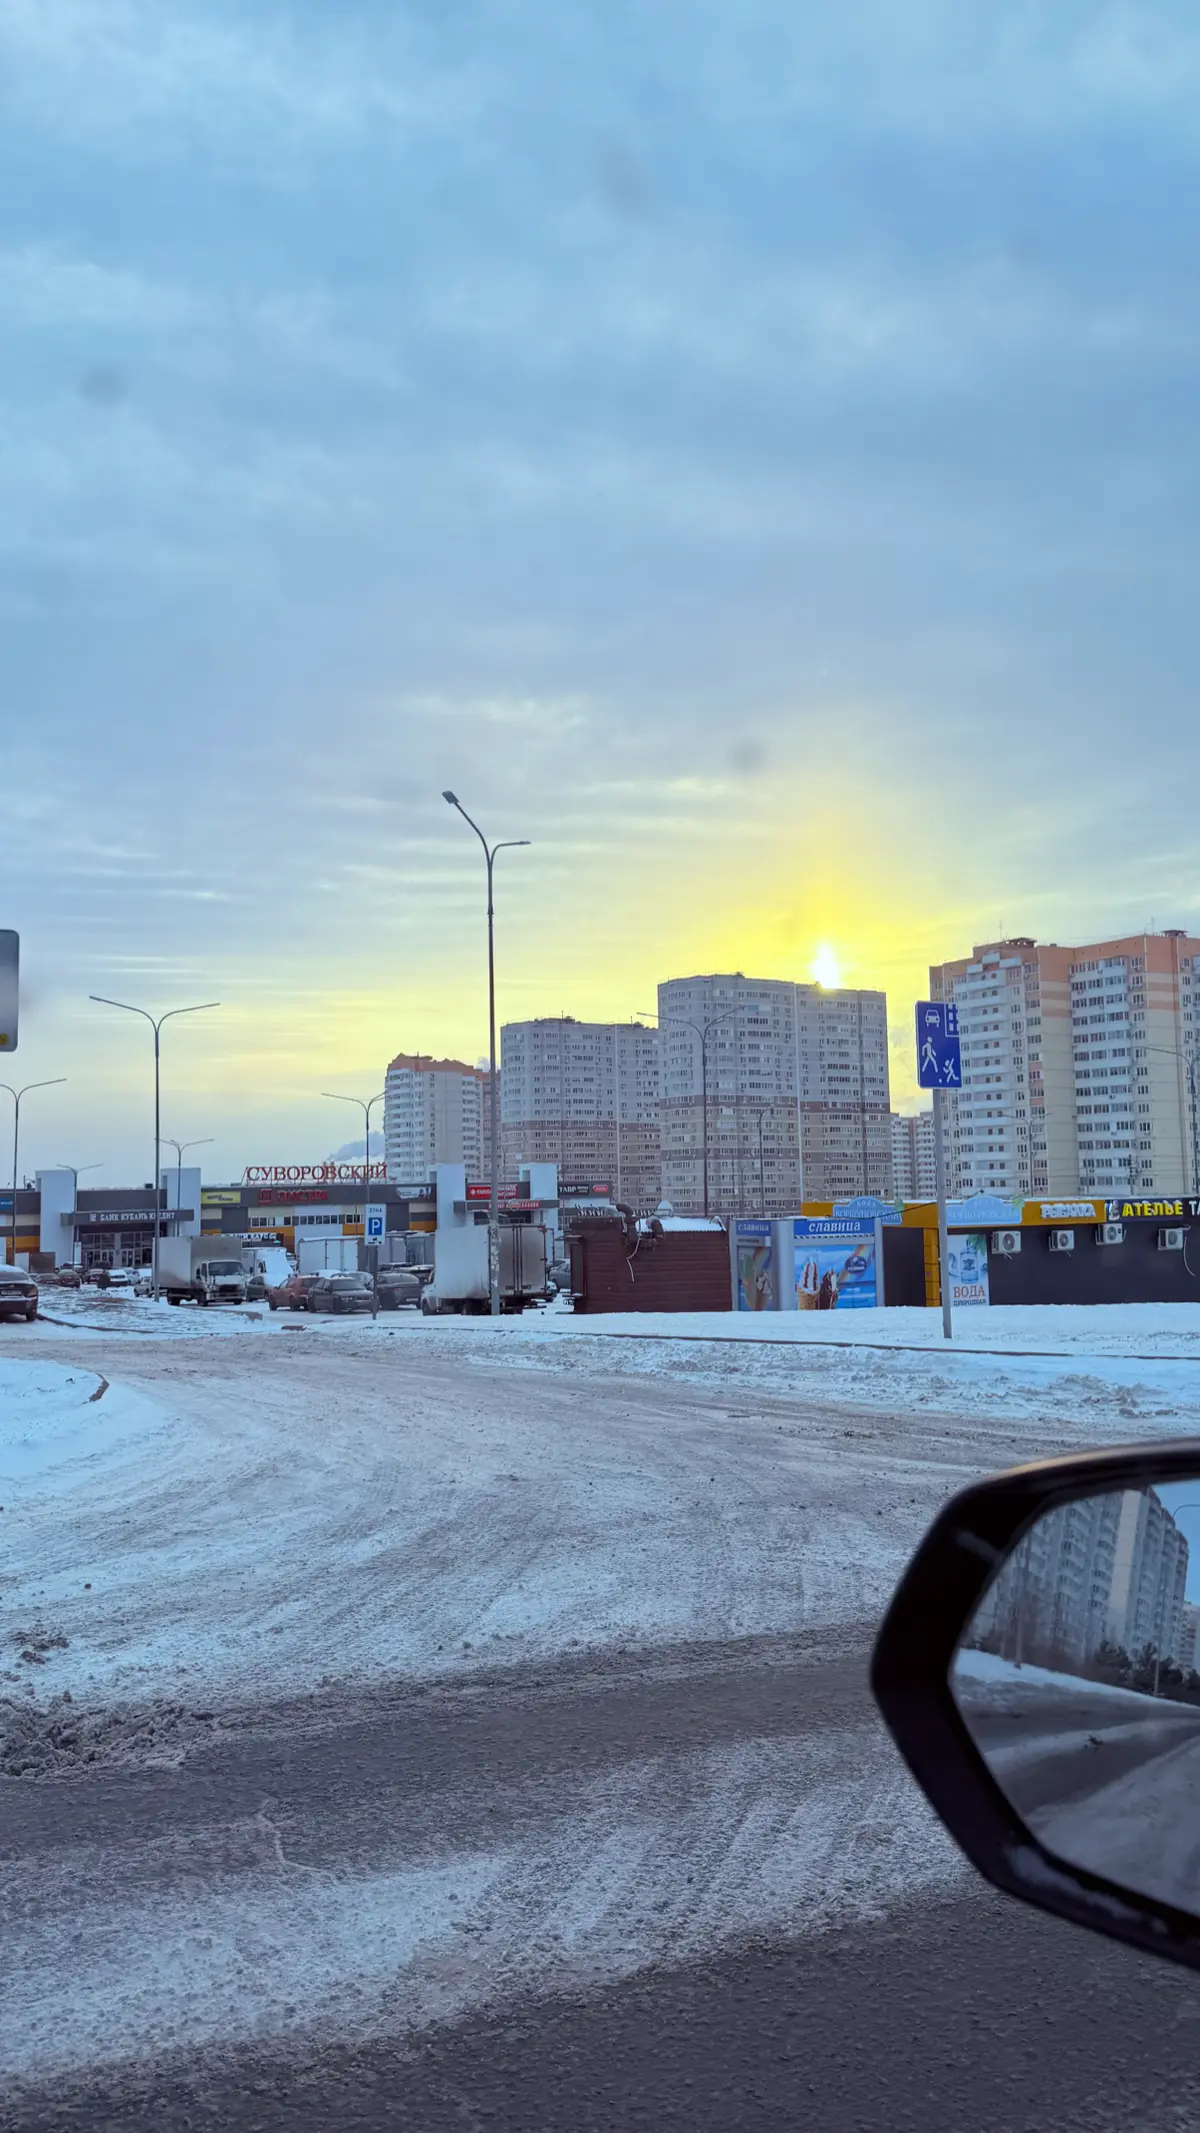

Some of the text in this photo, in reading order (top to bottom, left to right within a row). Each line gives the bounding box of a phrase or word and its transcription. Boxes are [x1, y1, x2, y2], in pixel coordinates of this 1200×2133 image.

[246, 1162, 387, 1181] СУВОРОВСКИЙ
[1122, 1200, 1183, 1217] АТЕЛЬЕ
[100, 1213, 119, 1221] БАНК
[120, 1212, 148, 1221] КУБАНЬ
[371, 1219, 380, 1234] P
[738, 1223, 769, 1232] славица
[809, 1220, 860, 1233] славица
[953, 1285, 986, 1298] ВОДА
